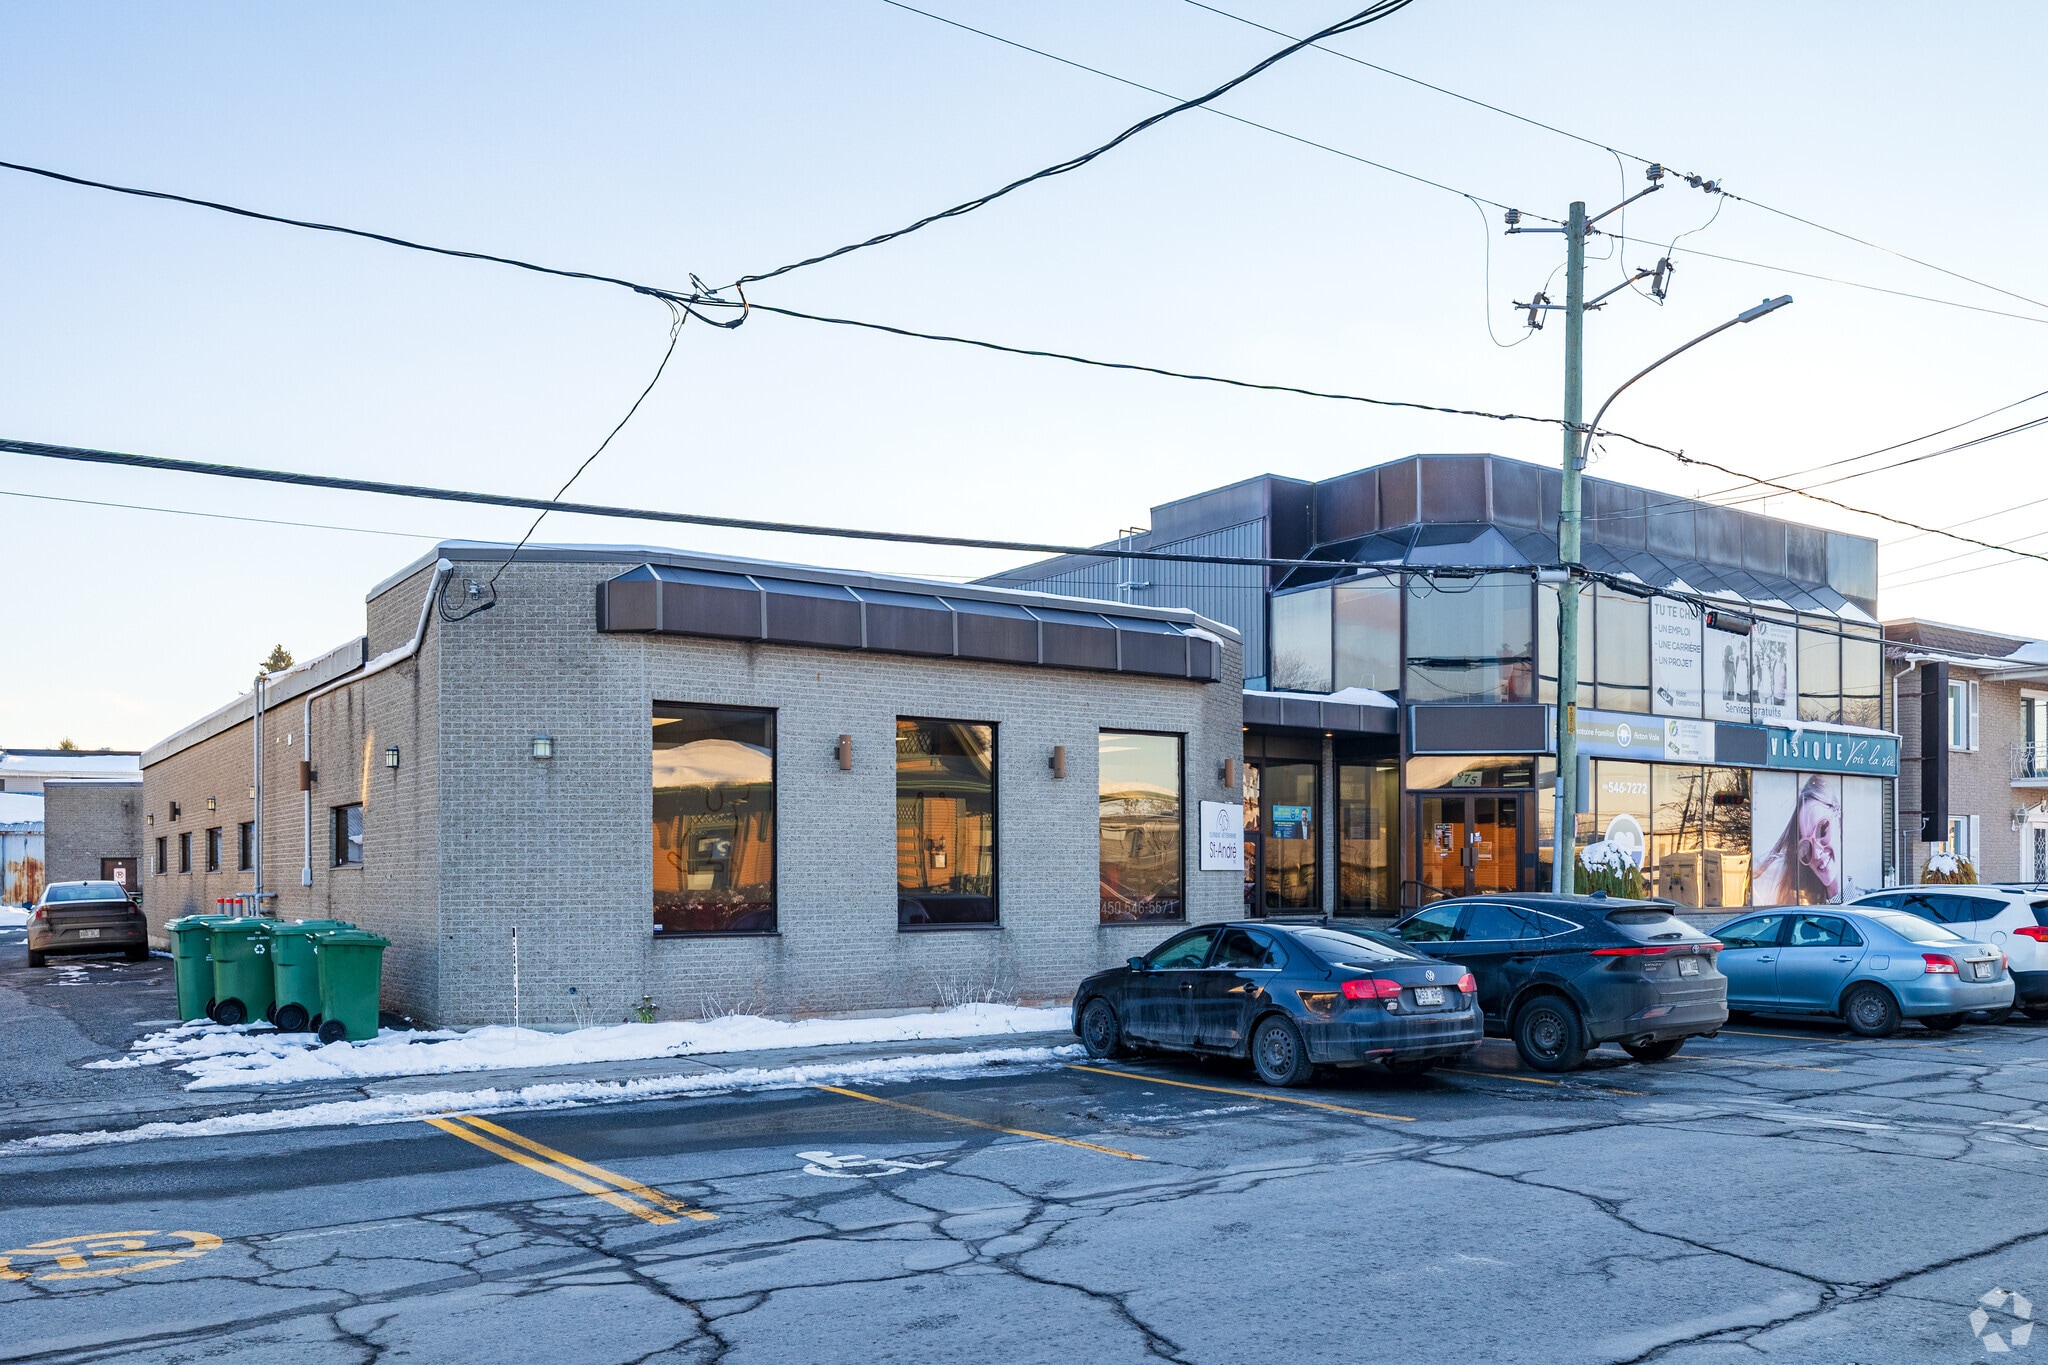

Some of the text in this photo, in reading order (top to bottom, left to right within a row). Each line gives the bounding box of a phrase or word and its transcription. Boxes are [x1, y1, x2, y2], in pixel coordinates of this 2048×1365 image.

[1655, 604, 1666, 616] TU
[1667, 605, 1678, 618] TE
[1658, 625, 1668, 633] UN
[1668, 626, 1691, 637] EMPLOI
[1658, 641, 1672, 650] UNE
[1658, 656, 1668, 665] UN
[1668, 657, 1693, 669] PROJET
[1725, 702, 1782, 718] Services gratuits
[1594, 728, 1615, 738] Familial
[1633, 731, 1649, 741] Acton
[1771, 737, 1842, 761] VISIQUE
[1844, 740, 1868, 767] Voir
[1868, 744, 1880, 766] la
[1209, 841, 1237, 859] St-André
[1101, 900, 1121, 915] 450
